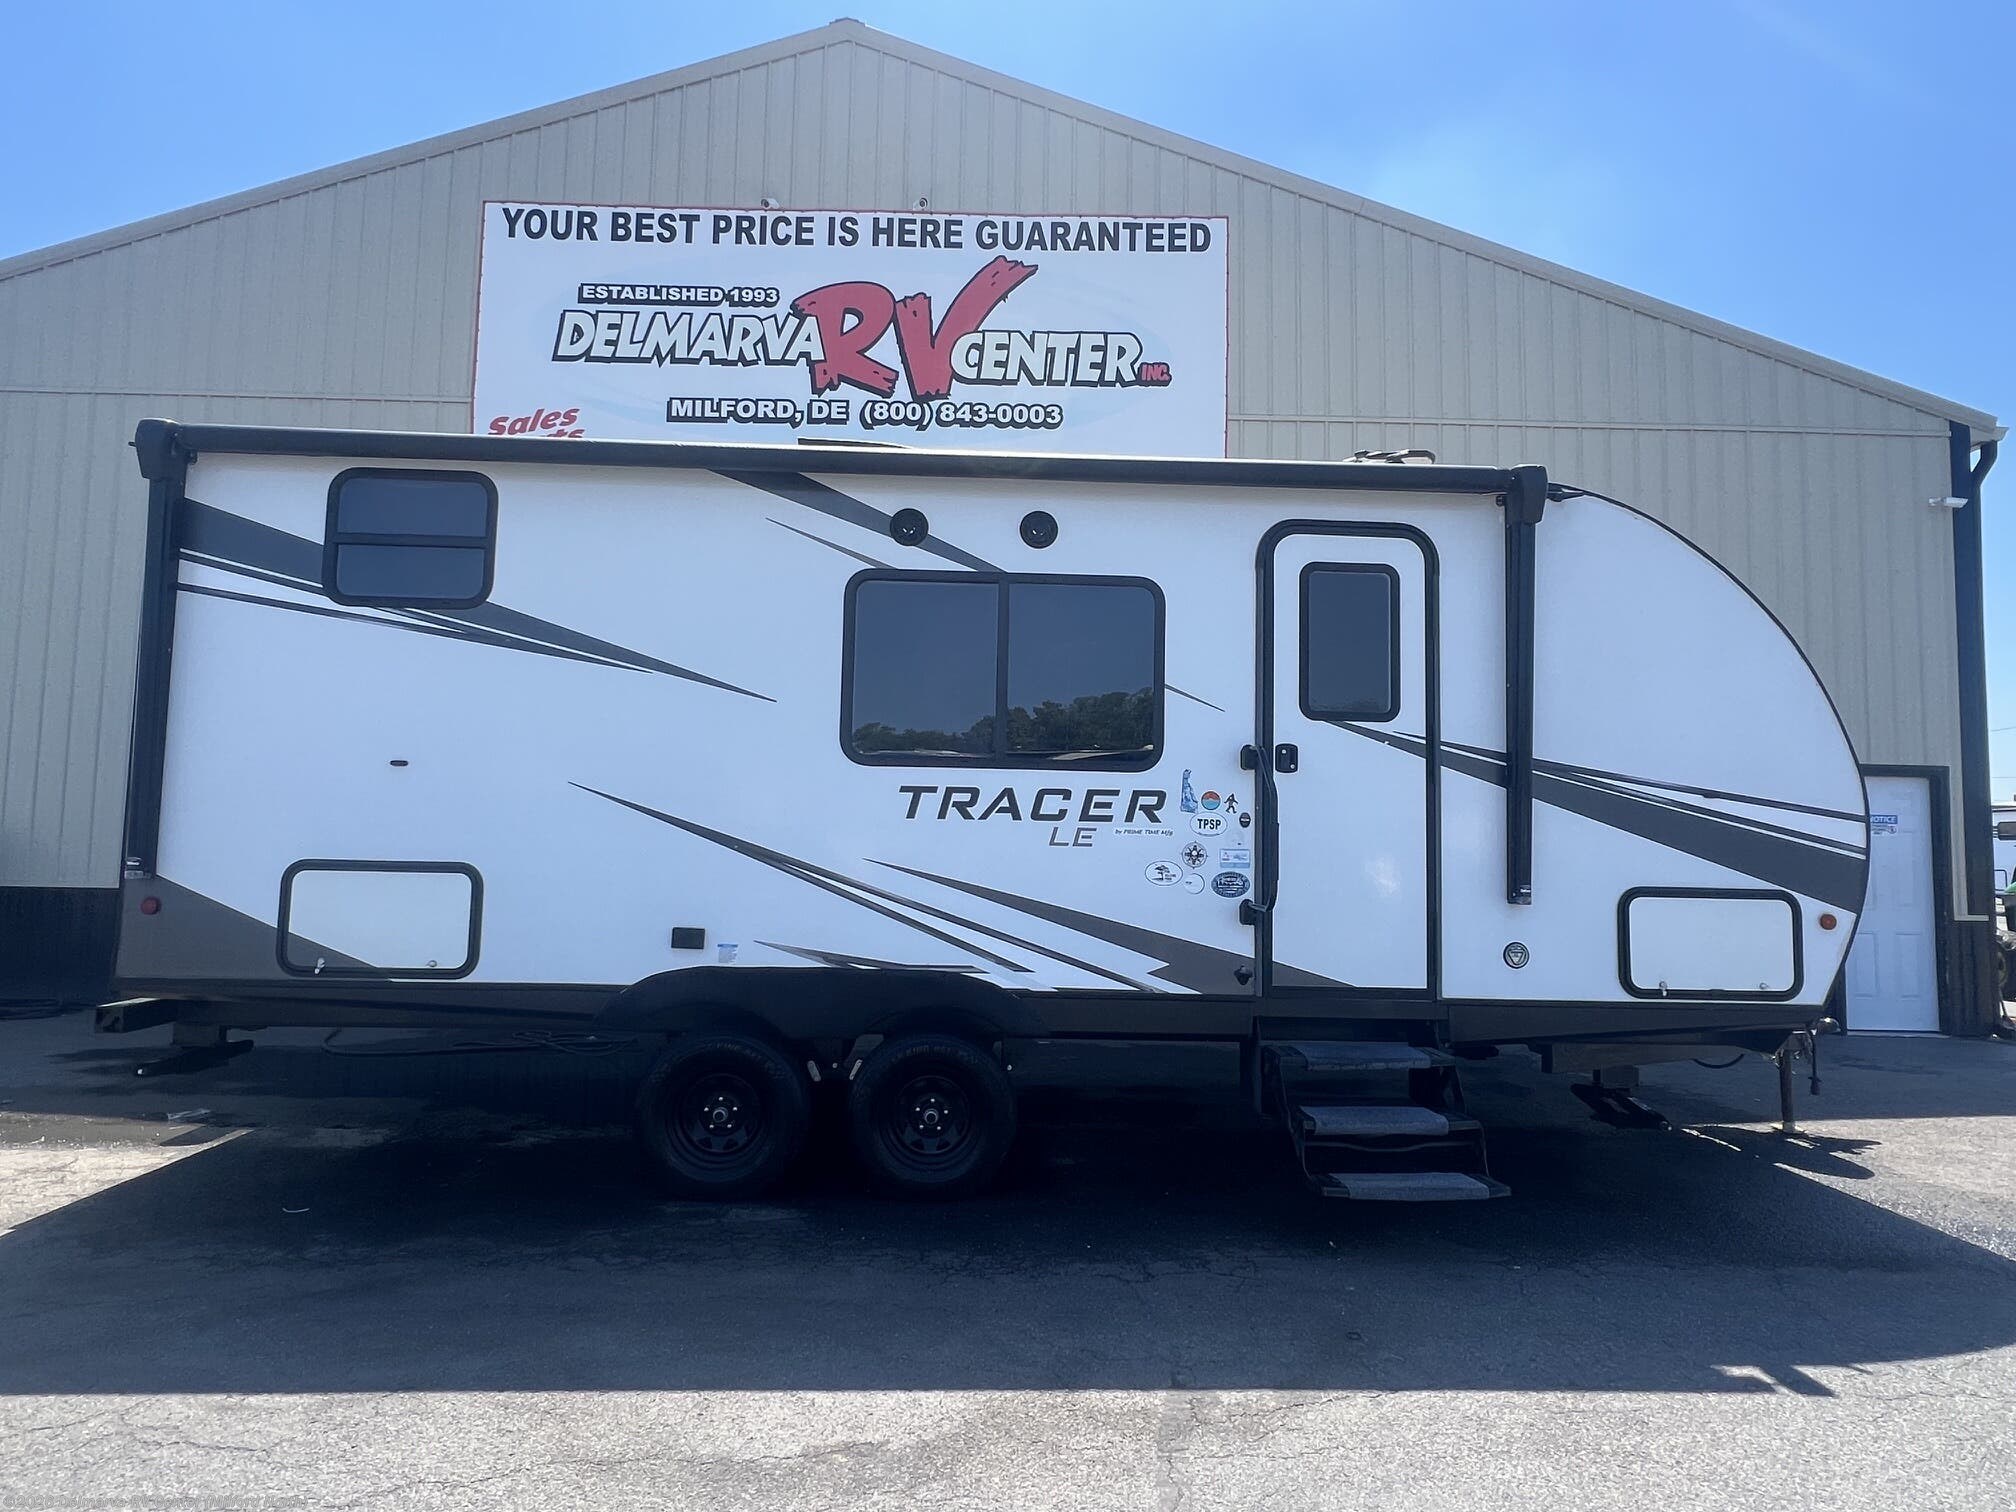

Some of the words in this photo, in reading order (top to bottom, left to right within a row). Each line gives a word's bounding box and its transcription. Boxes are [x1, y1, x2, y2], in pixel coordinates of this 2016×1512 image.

[502, 207, 598, 241] YOUR
[610, 211, 701, 244] BEST
[712, 214, 815, 246] PRICE
[827, 216, 860, 247] IS
[872, 217, 964, 249] HERE
[976, 220, 1212, 252] GUARANTEED
[580, 284, 724, 303] ESTABLISHED
[729, 287, 780, 304] 1993
[553, 310, 827, 367] DELMARVA
[790, 255, 1039, 401] RV
[951, 331, 1143, 387] CENTER
[488, 408, 580, 435] sales
[668, 399, 804, 427] MILFORD,
[808, 400, 849, 425] DE
[860, 401, 932, 430] (800)
[937, 404, 1063, 428] 843-0003
[899, 786, 1167, 823] TRACER
[1049, 826, 1097, 847] LE
[1197, 818, 1222, 830] TPSP
